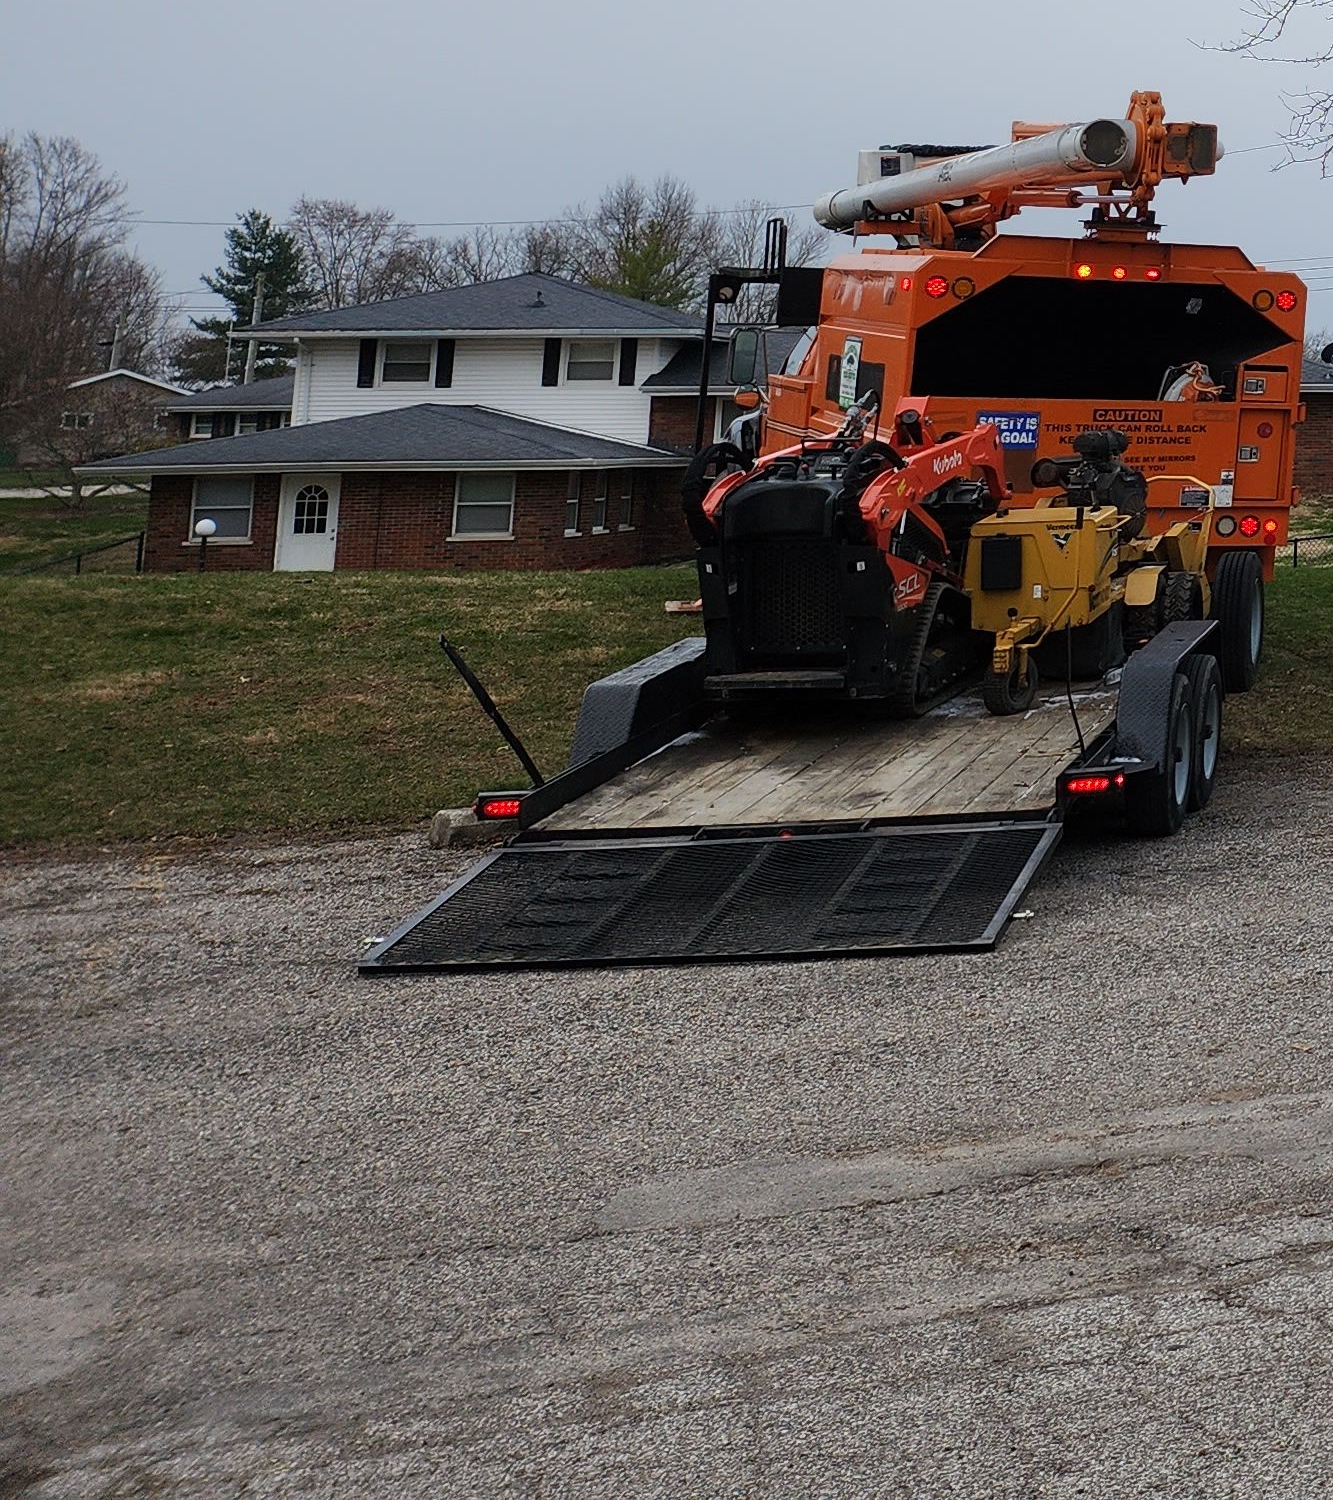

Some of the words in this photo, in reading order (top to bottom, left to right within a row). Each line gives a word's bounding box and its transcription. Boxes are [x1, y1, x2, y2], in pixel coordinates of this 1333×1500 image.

[1095, 410, 1160, 421] CAUTION
[1025, 417, 1038, 430] IS
[1045, 423, 1072, 432] THIS
[1118, 424, 1142, 432] CAN
[1145, 424, 1174, 433] ROLL
[1176, 424, 1207, 433] BACK
[1001, 431, 1036, 444] GOAL
[1136, 436, 1192, 445] DISTANCE
[933, 449, 963, 475] Kubota
